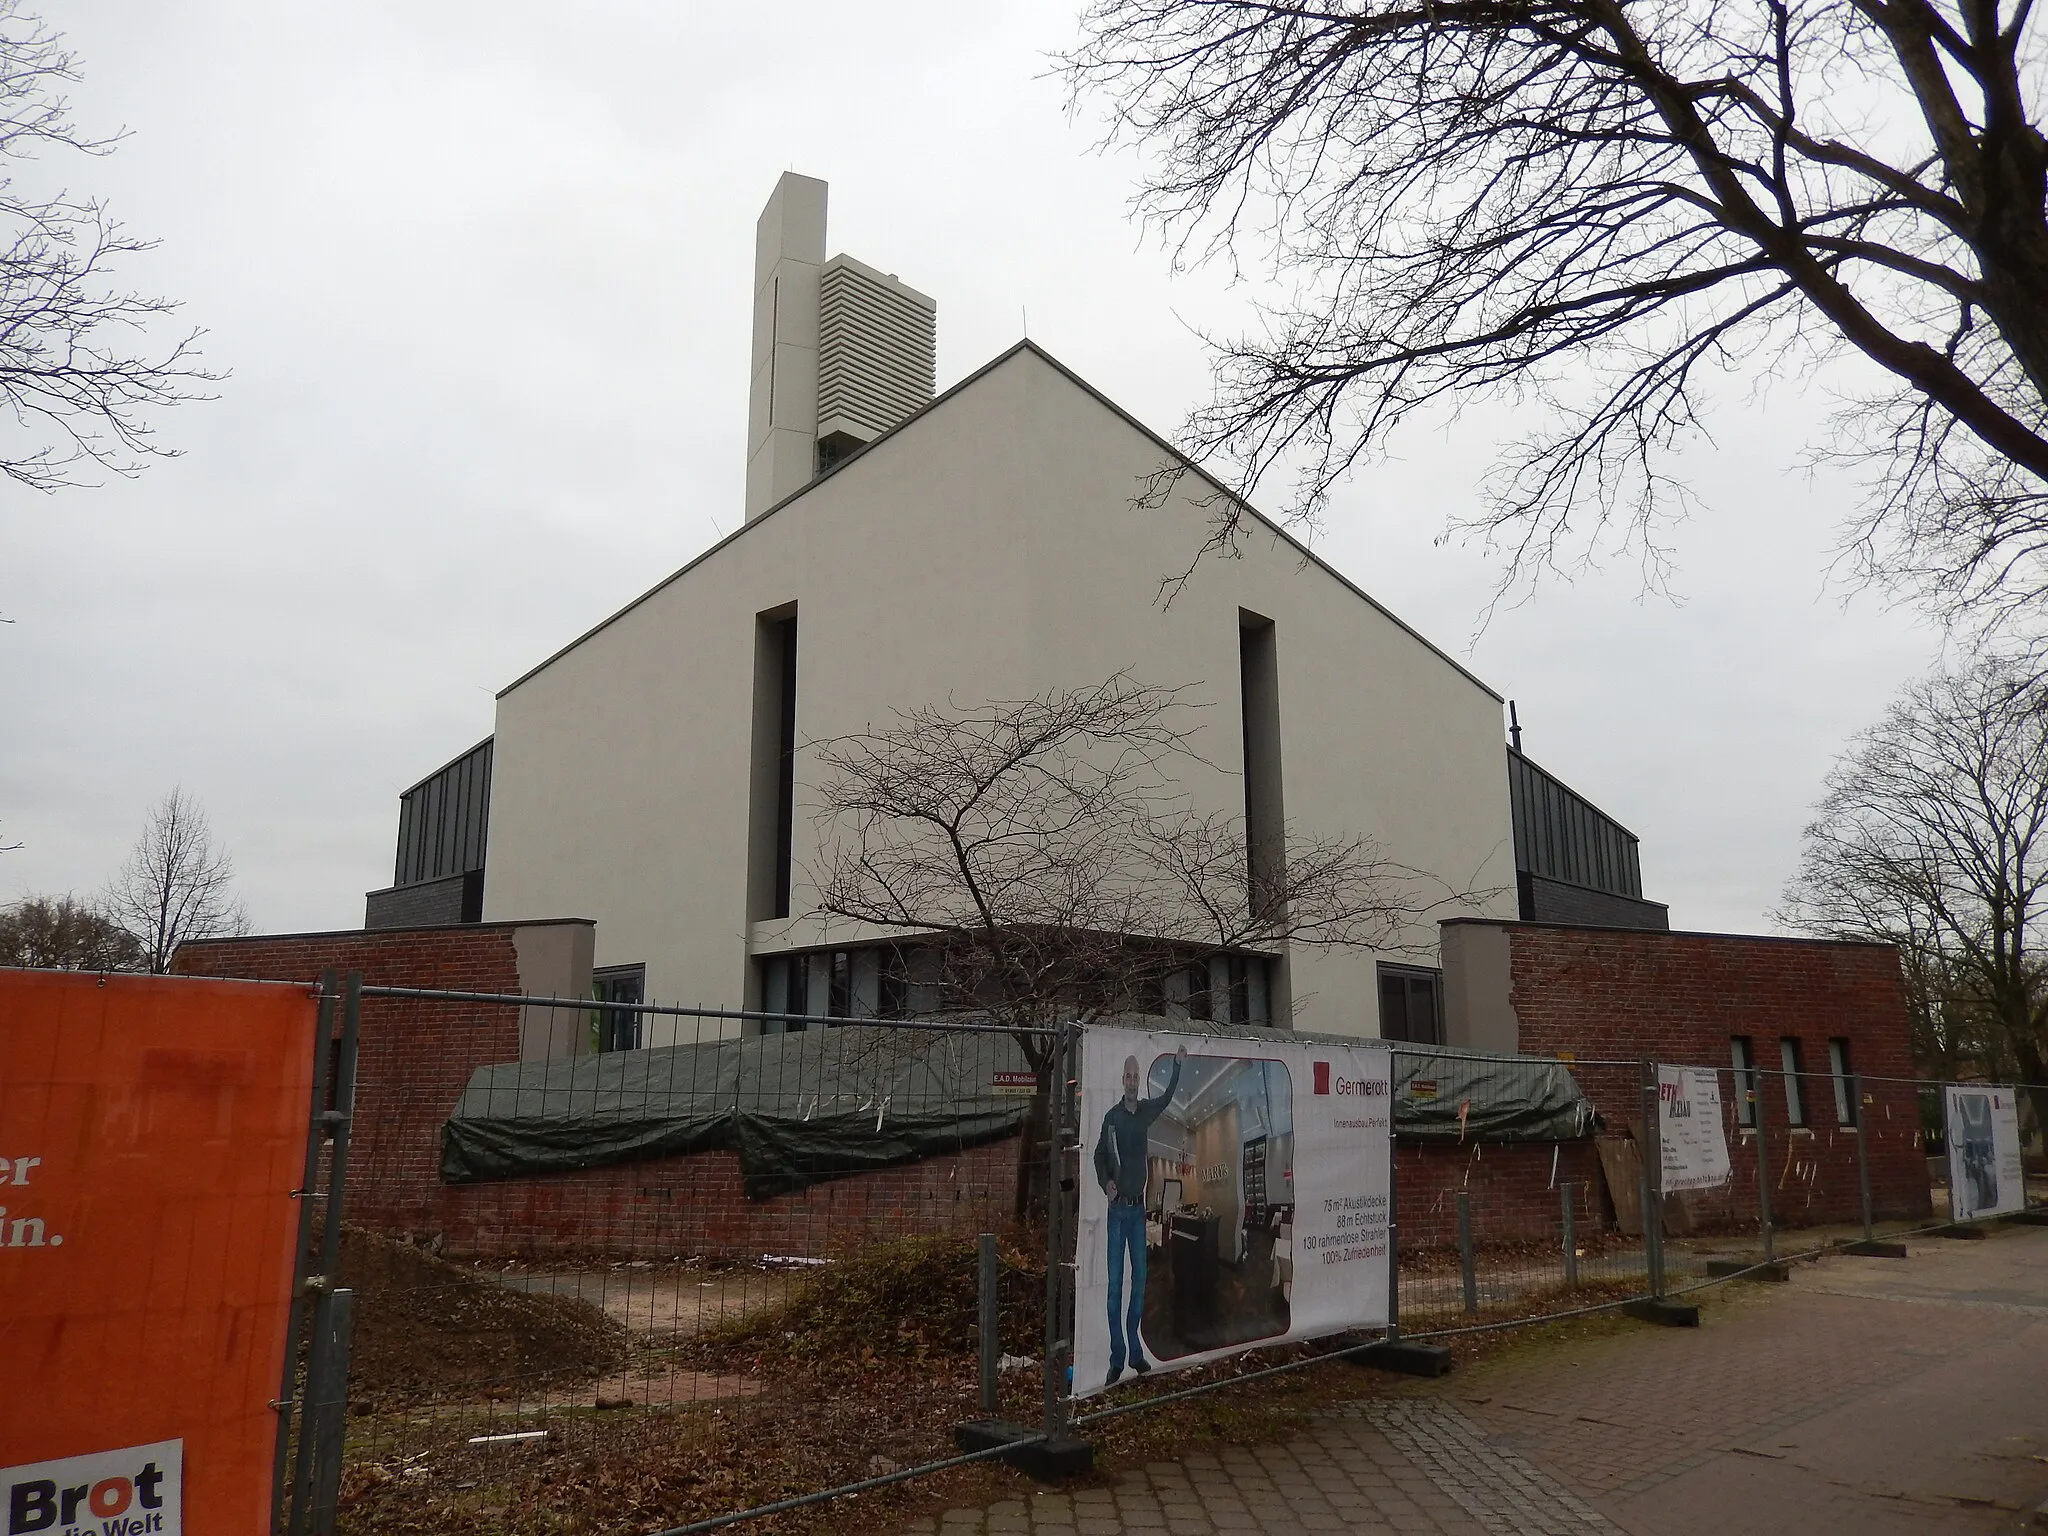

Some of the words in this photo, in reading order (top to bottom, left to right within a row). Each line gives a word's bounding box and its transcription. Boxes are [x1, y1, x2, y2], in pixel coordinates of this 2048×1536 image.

[1336, 1076, 1388, 1095] Germerott
[1344, 1195, 1386, 1209] Akustikdecke
[1337, 1215, 1345, 1228] 88
[1303, 1236, 1317, 1250] 130
[1318, 1231, 1359, 1248] rahmenlose
[1361, 1227, 1386, 1242] Strahler
[1323, 1250, 1342, 1265] 100%
[1344, 1243, 1386, 1262] Zufriedenheit
[9, 1462, 163, 1536] Brot
[102, 1513, 163, 1536] Welt
